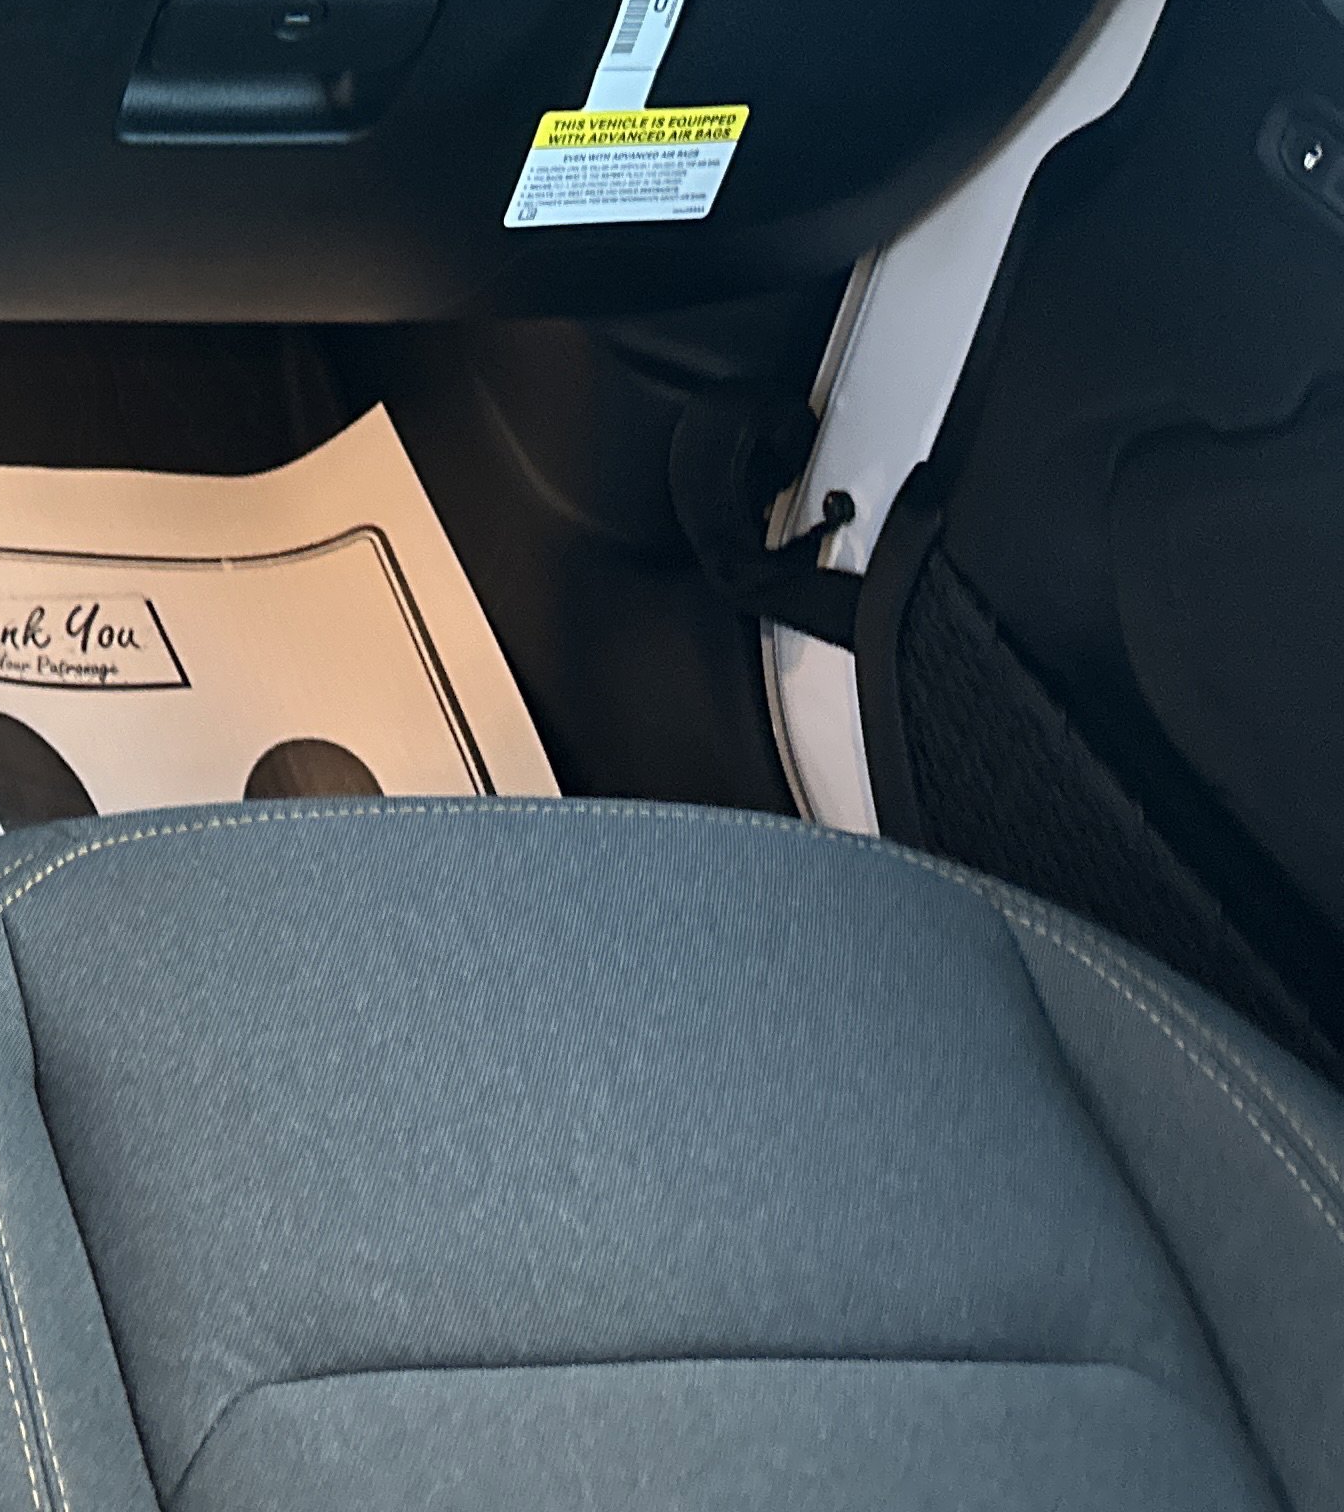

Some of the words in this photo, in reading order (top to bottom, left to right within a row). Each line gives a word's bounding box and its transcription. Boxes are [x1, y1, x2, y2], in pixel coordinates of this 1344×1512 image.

[553, 118, 586, 133] THIS
[589, 116, 648, 131] VEHICLE
[650, 116, 665, 128] IS
[667, 113, 737, 128] EQUIPPED
[548, 133, 585, 146] WITH
[586, 130, 664, 145] ADVANCED
[671, 128, 691, 142] AIR
[694, 127, 732, 141] BAGS
[65, 601, 143, 655] You
[37, 653, 120, 686] Patronage
